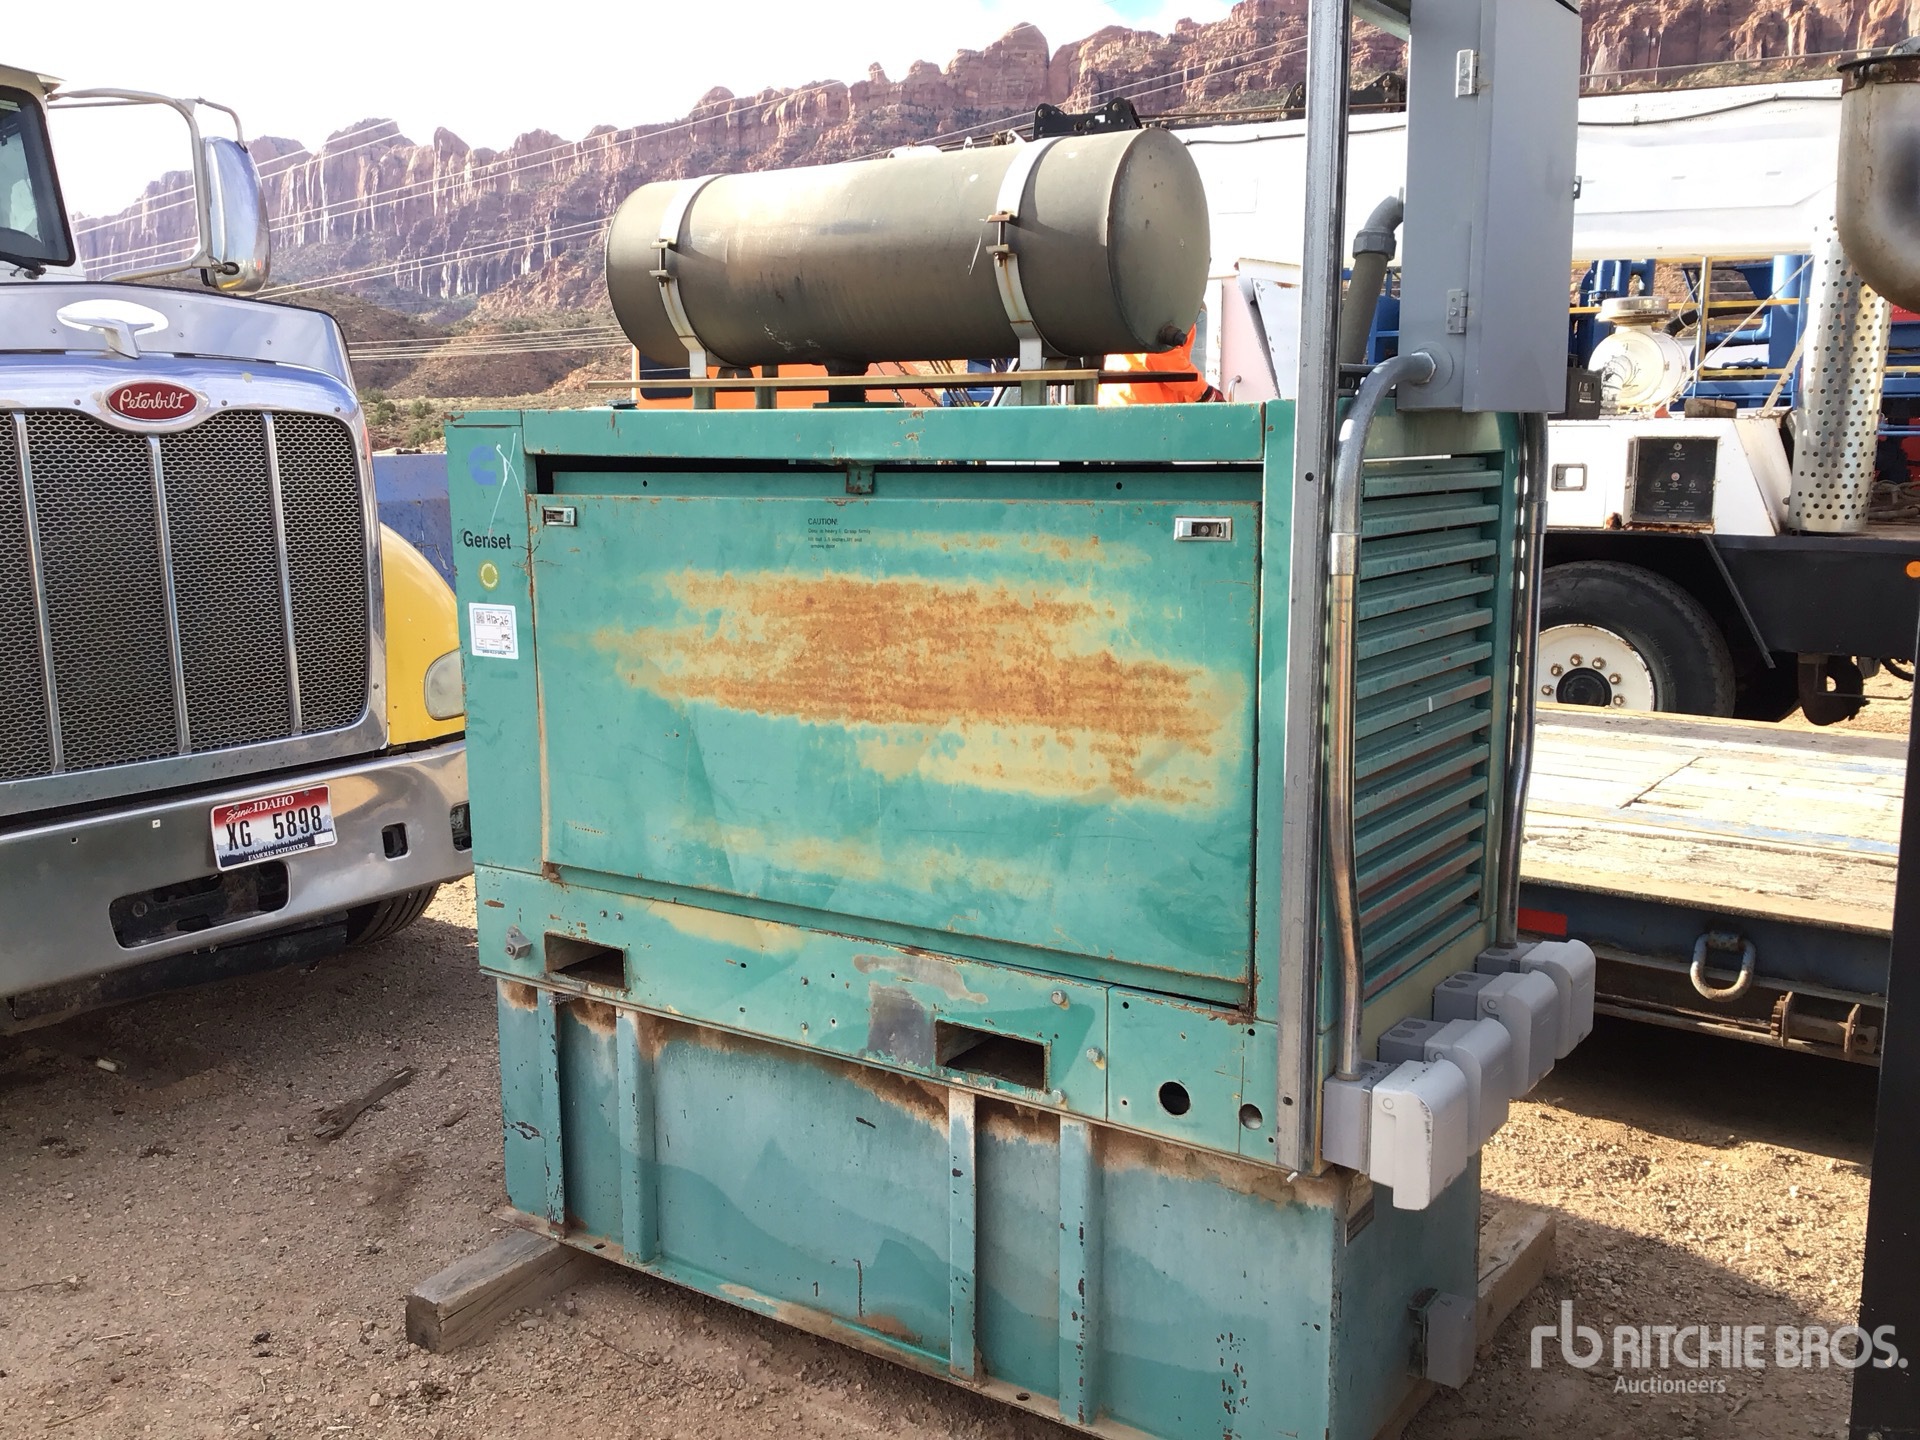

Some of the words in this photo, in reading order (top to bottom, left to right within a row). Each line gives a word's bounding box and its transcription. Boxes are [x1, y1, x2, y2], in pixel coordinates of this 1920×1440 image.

[119, 389, 190, 411] Peterbilt
[463, 530, 512, 550] Genset
[226, 806, 254, 823] Scenic
[253, 795, 295, 813] IDAHO
[225, 820, 253, 851] XG
[272, 804, 323, 840] 5898
[248, 849, 275, 861] FAMOUS
[275, 842, 309, 855] POTATOES
